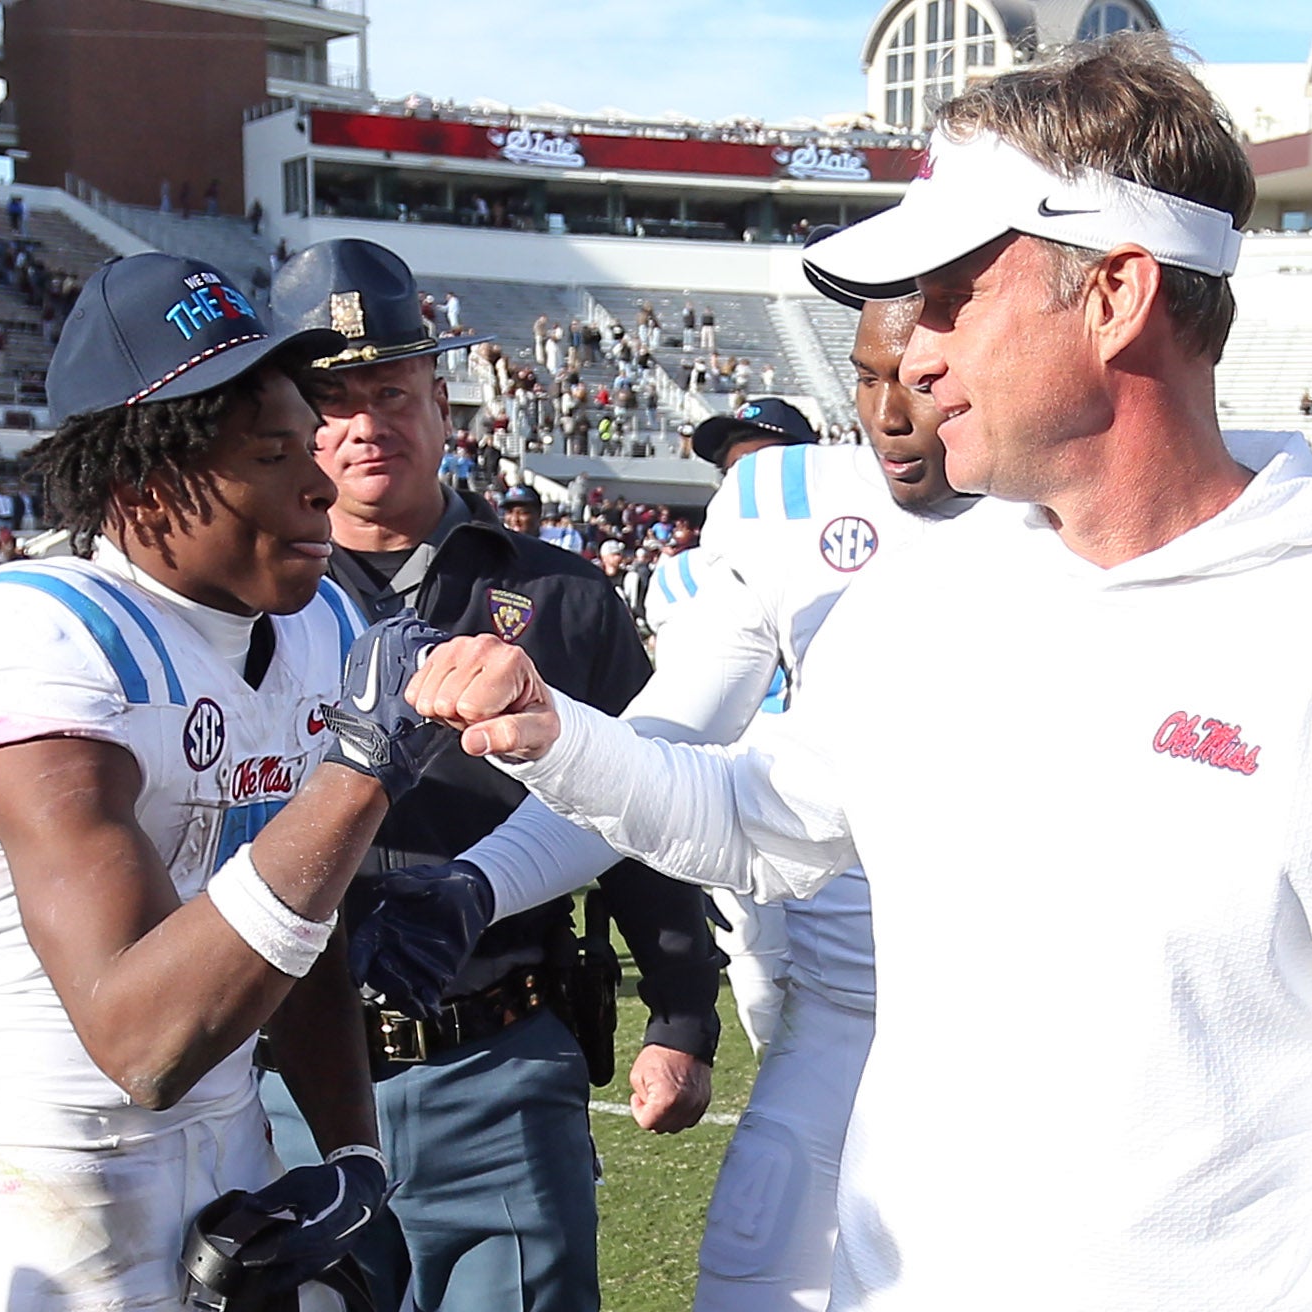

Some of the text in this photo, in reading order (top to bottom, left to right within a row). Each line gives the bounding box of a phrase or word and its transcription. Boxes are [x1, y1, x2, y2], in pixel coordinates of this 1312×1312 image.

[501, 129, 585, 167] State
[788, 142, 871, 180] State
[165, 287, 223, 340] THE
[822, 518, 875, 570] SEC
[188, 703, 222, 767] SEC
[1153, 711, 1261, 776] Ole Miss
[231, 755, 294, 801] Ole Miss
